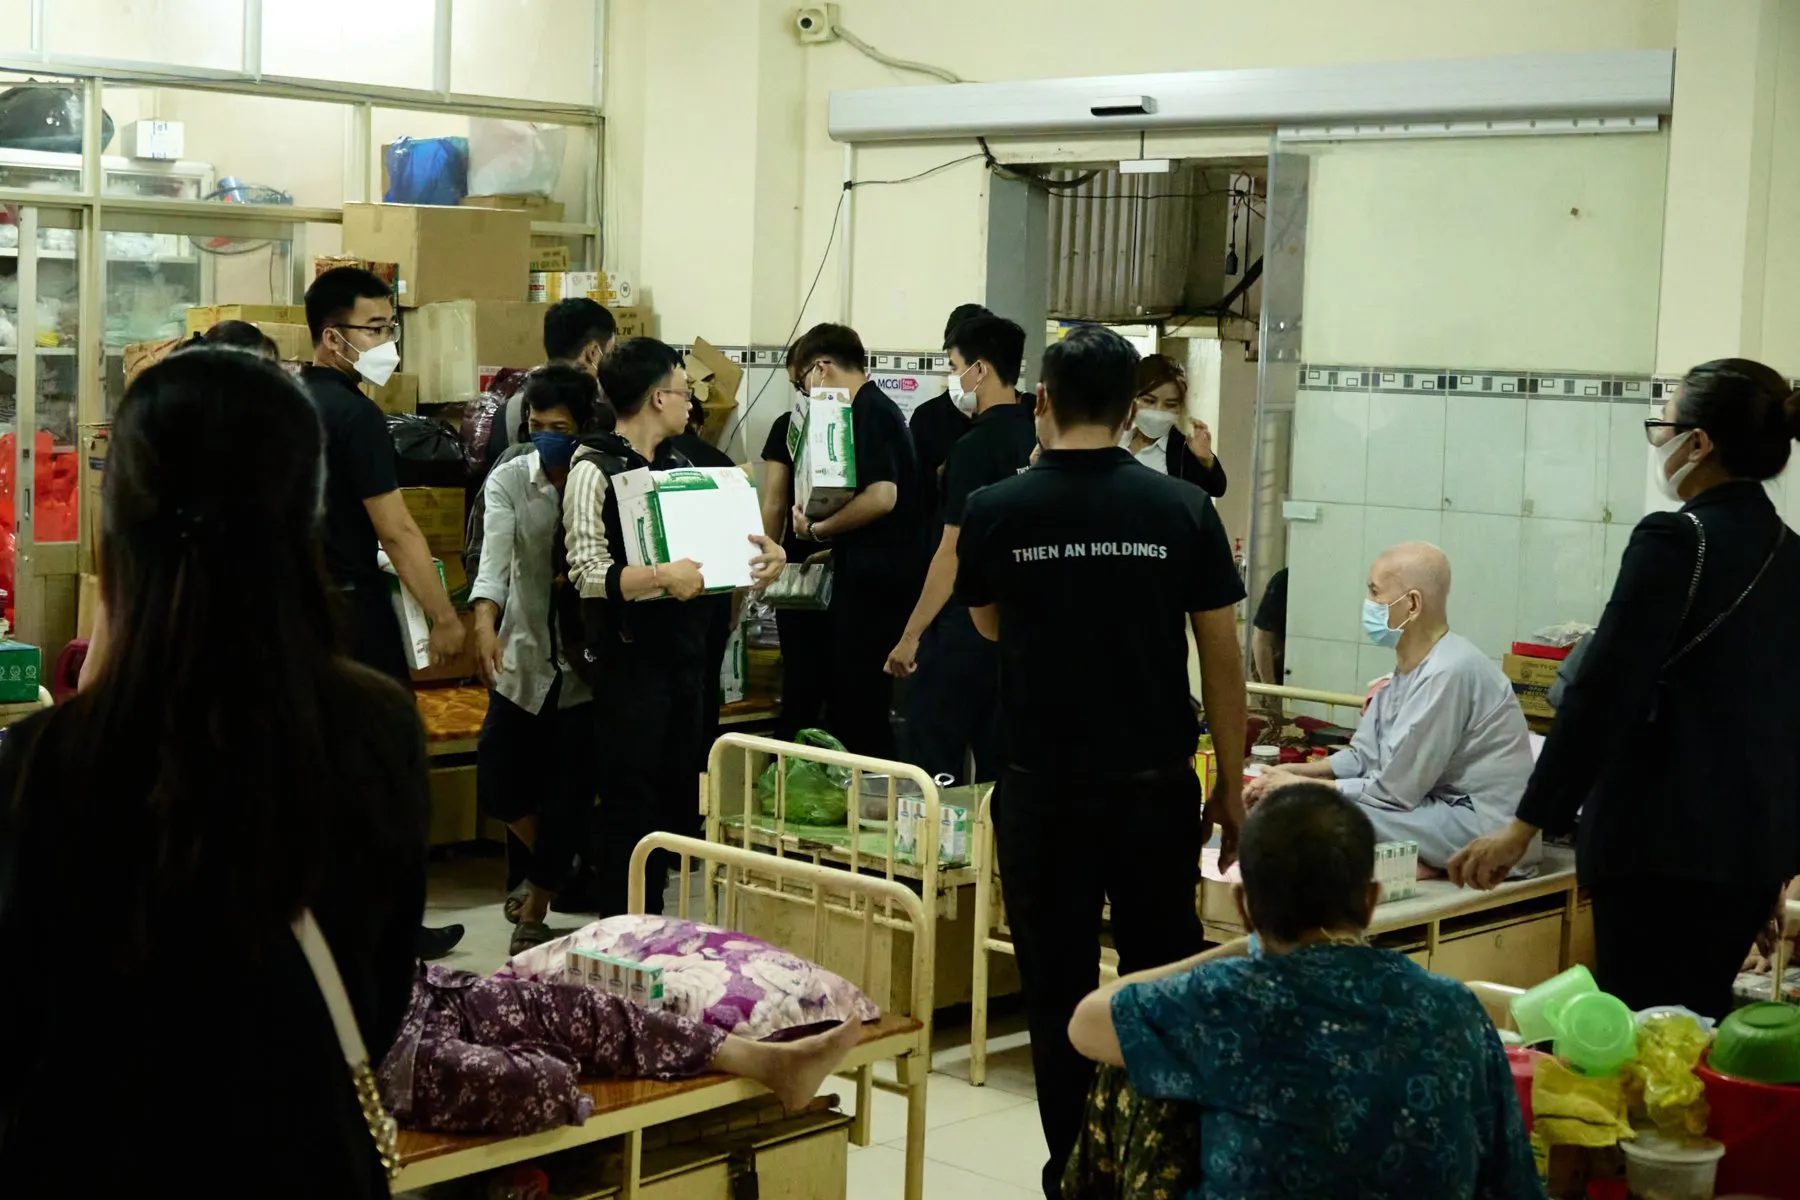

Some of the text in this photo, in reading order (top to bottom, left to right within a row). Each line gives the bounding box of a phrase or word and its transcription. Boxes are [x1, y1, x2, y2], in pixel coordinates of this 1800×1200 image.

[877, 378, 901, 389] MCGI
[1012, 541, 1168, 563] THIEN AN HOLDINGS
